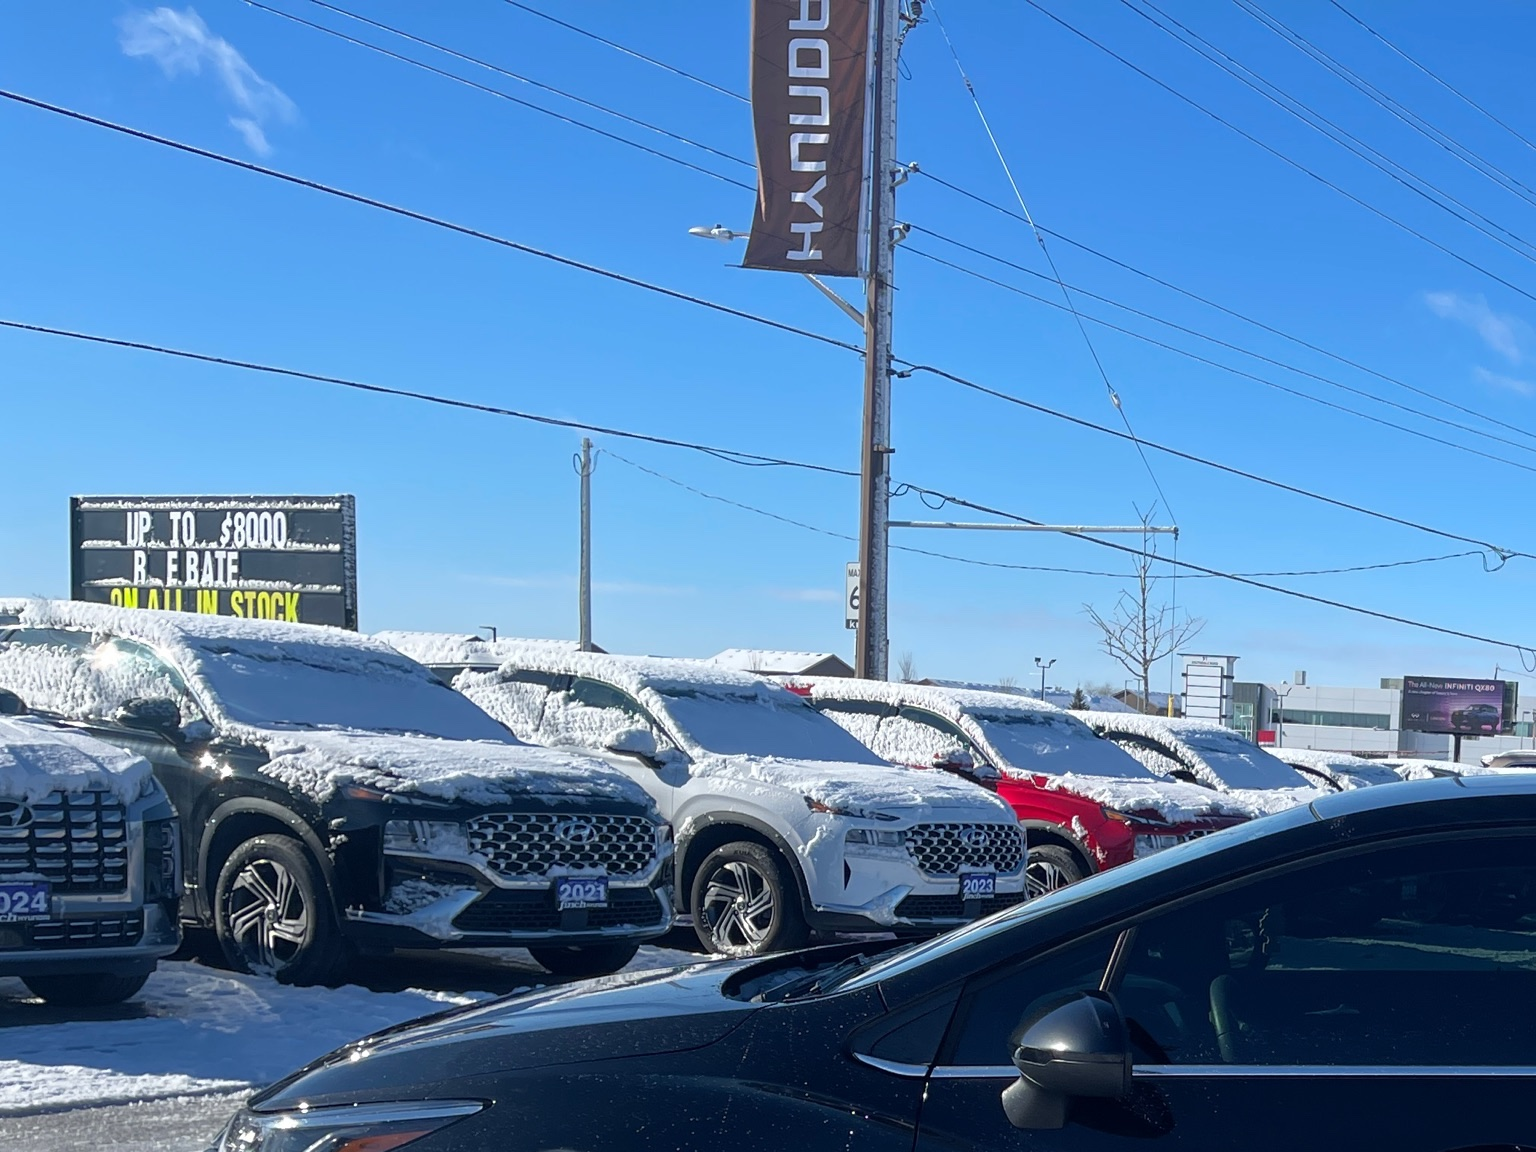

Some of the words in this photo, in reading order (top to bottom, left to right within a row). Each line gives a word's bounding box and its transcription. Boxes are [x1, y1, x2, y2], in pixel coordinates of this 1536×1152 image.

[126, 511, 152, 548] UP
[169, 511, 195, 549] TO
[220, 511, 288, 549] $8000
[230, 591, 301, 623] STOCK
[1407, 680, 1419, 688] The
[1444, 682, 1473, 690] INFINITI
[1474, 683, 1495, 692] QX80
[560, 884, 605, 901] 2021
[963, 879, 993, 893] 2023
